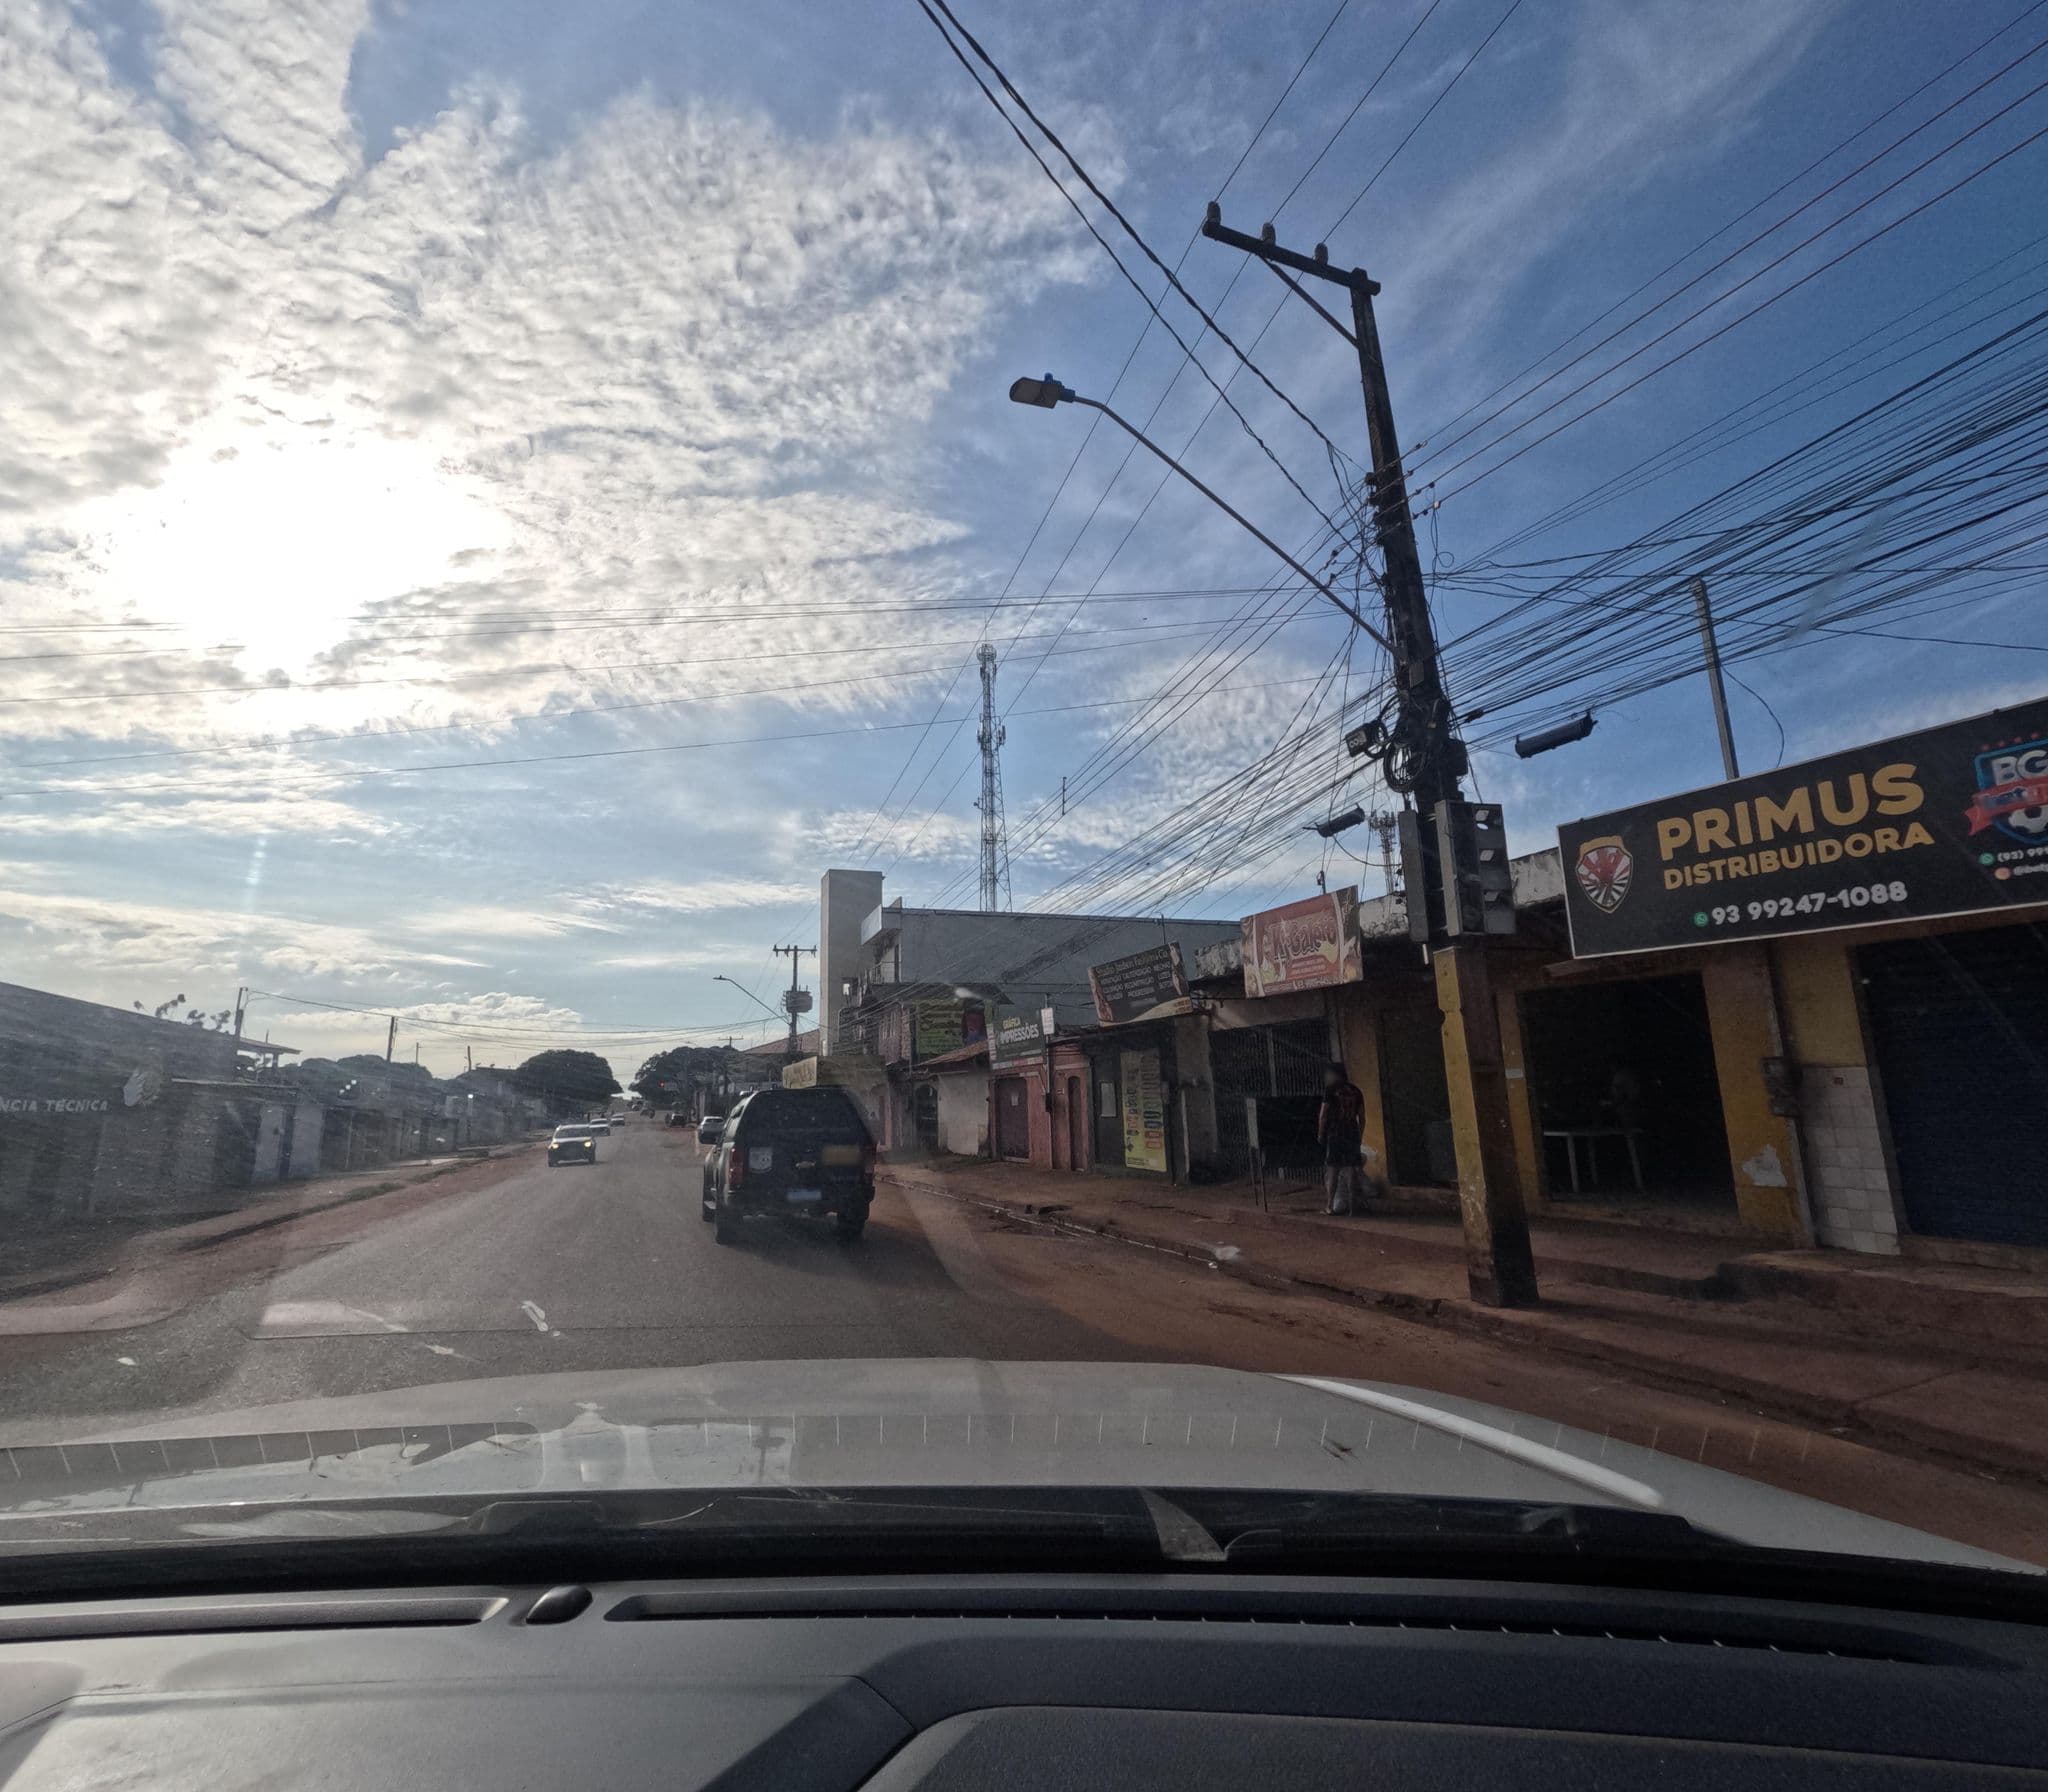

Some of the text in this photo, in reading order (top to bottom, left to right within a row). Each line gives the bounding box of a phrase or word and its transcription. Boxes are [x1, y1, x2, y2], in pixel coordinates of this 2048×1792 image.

[1657, 763, 1925, 861] PRIMUS
[1664, 822, 1936, 891] DISTRIBUIDORA
[1997, 850, 2024, 862] (93)
[1711, 881, 1908, 925] 93 99247-1088
[998, 1022, 1040, 1044] IMPRESSÕES
[46, 1097, 109, 1112] TÉCNICA
